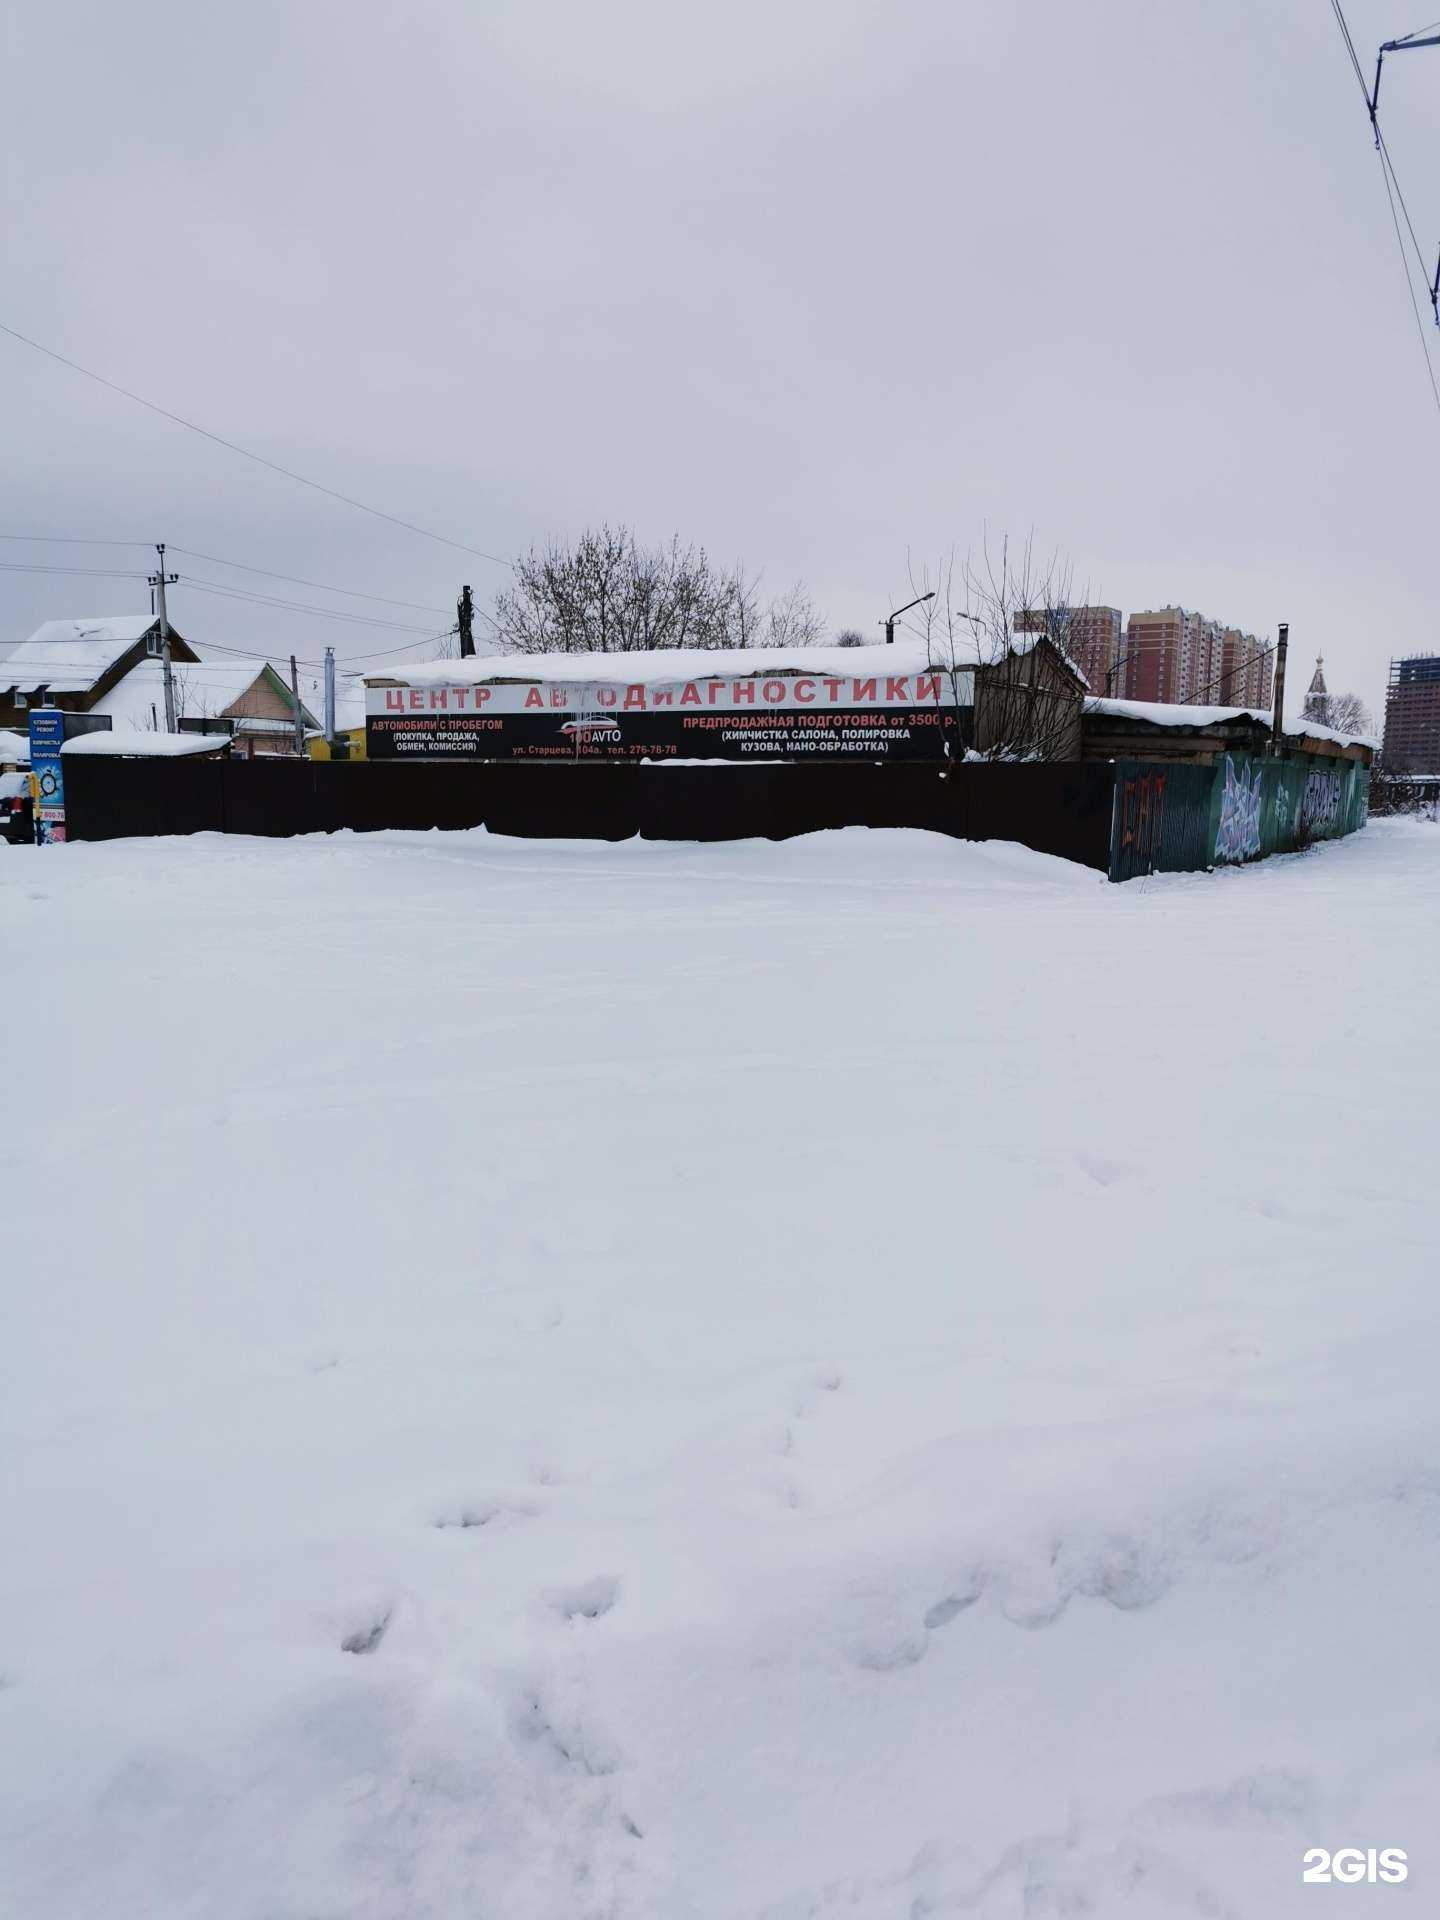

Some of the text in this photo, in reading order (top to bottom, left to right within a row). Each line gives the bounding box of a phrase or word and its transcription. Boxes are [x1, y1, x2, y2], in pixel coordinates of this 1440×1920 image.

[386, 676, 942, 713] ЦЕНТР АВОДИАГНОСТИКИ
[371, 719, 503, 731] АВТОМОБИЛИ С ПРОБЕГОМ
[683, 716, 794, 729] ПРЕДПРОДАЖНАЯ
[798, 714, 887, 728] ПОДГОТОВКА
[890, 717, 905, 726] от
[908, 714, 940, 726] 3500
[393, 732, 480, 742] (ПОКУПКА, ПРОДАЖА,
[721, 729, 911, 741] (ХИМЧИСТКА САЛОНА, ПОЛИРОВКА
[396, 742, 477, 752] ОБМЕН, КОМИССИЯ)
[512, 747, 526, 755] ул.
[528, 745, 574, 756] Старцева,
[607, 747, 627, 755] тел.
[740, 741, 889, 752] КУЗОВА, НАНО-ОБРАБОТКА)
